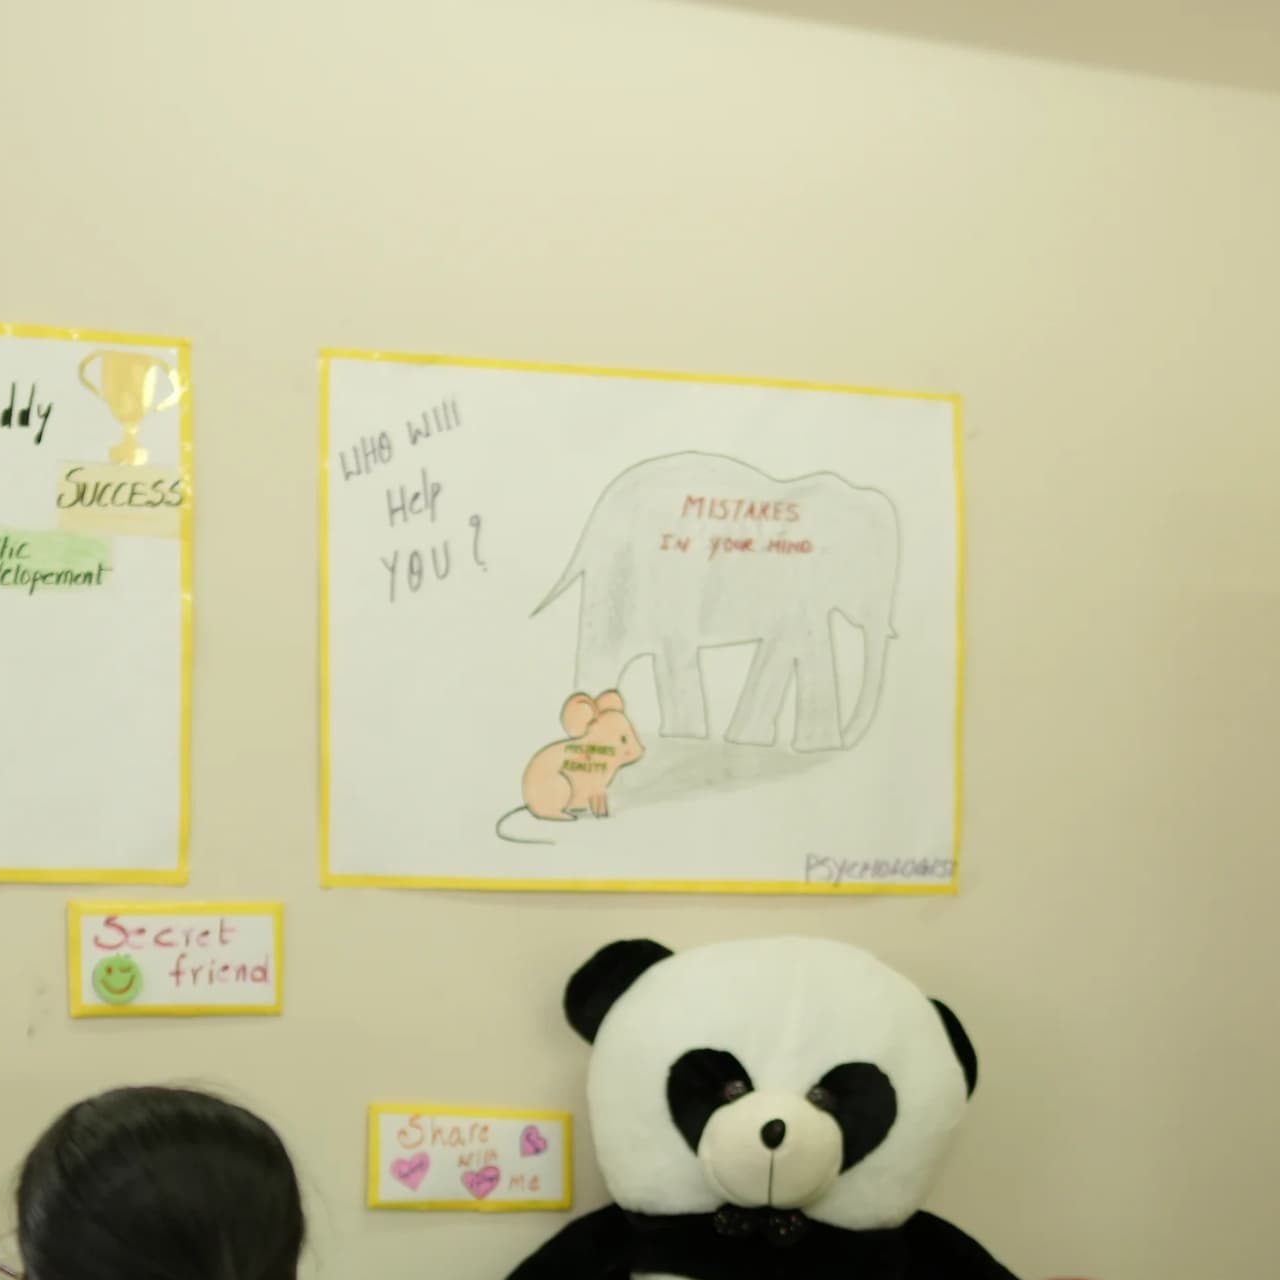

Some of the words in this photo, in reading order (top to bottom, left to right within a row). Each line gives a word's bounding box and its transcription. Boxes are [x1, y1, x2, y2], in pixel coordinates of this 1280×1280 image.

[339, 431, 393, 481] WHO
[56, 466, 185, 509] SUCCESS
[386, 467, 442, 527] Help
[682, 493, 800, 522] MISTAKES
[768, 537, 813, 554] MIND
[93, 916, 236, 950] Secret
[169, 953, 270, 987] friend
[396, 1114, 490, 1149] Share
